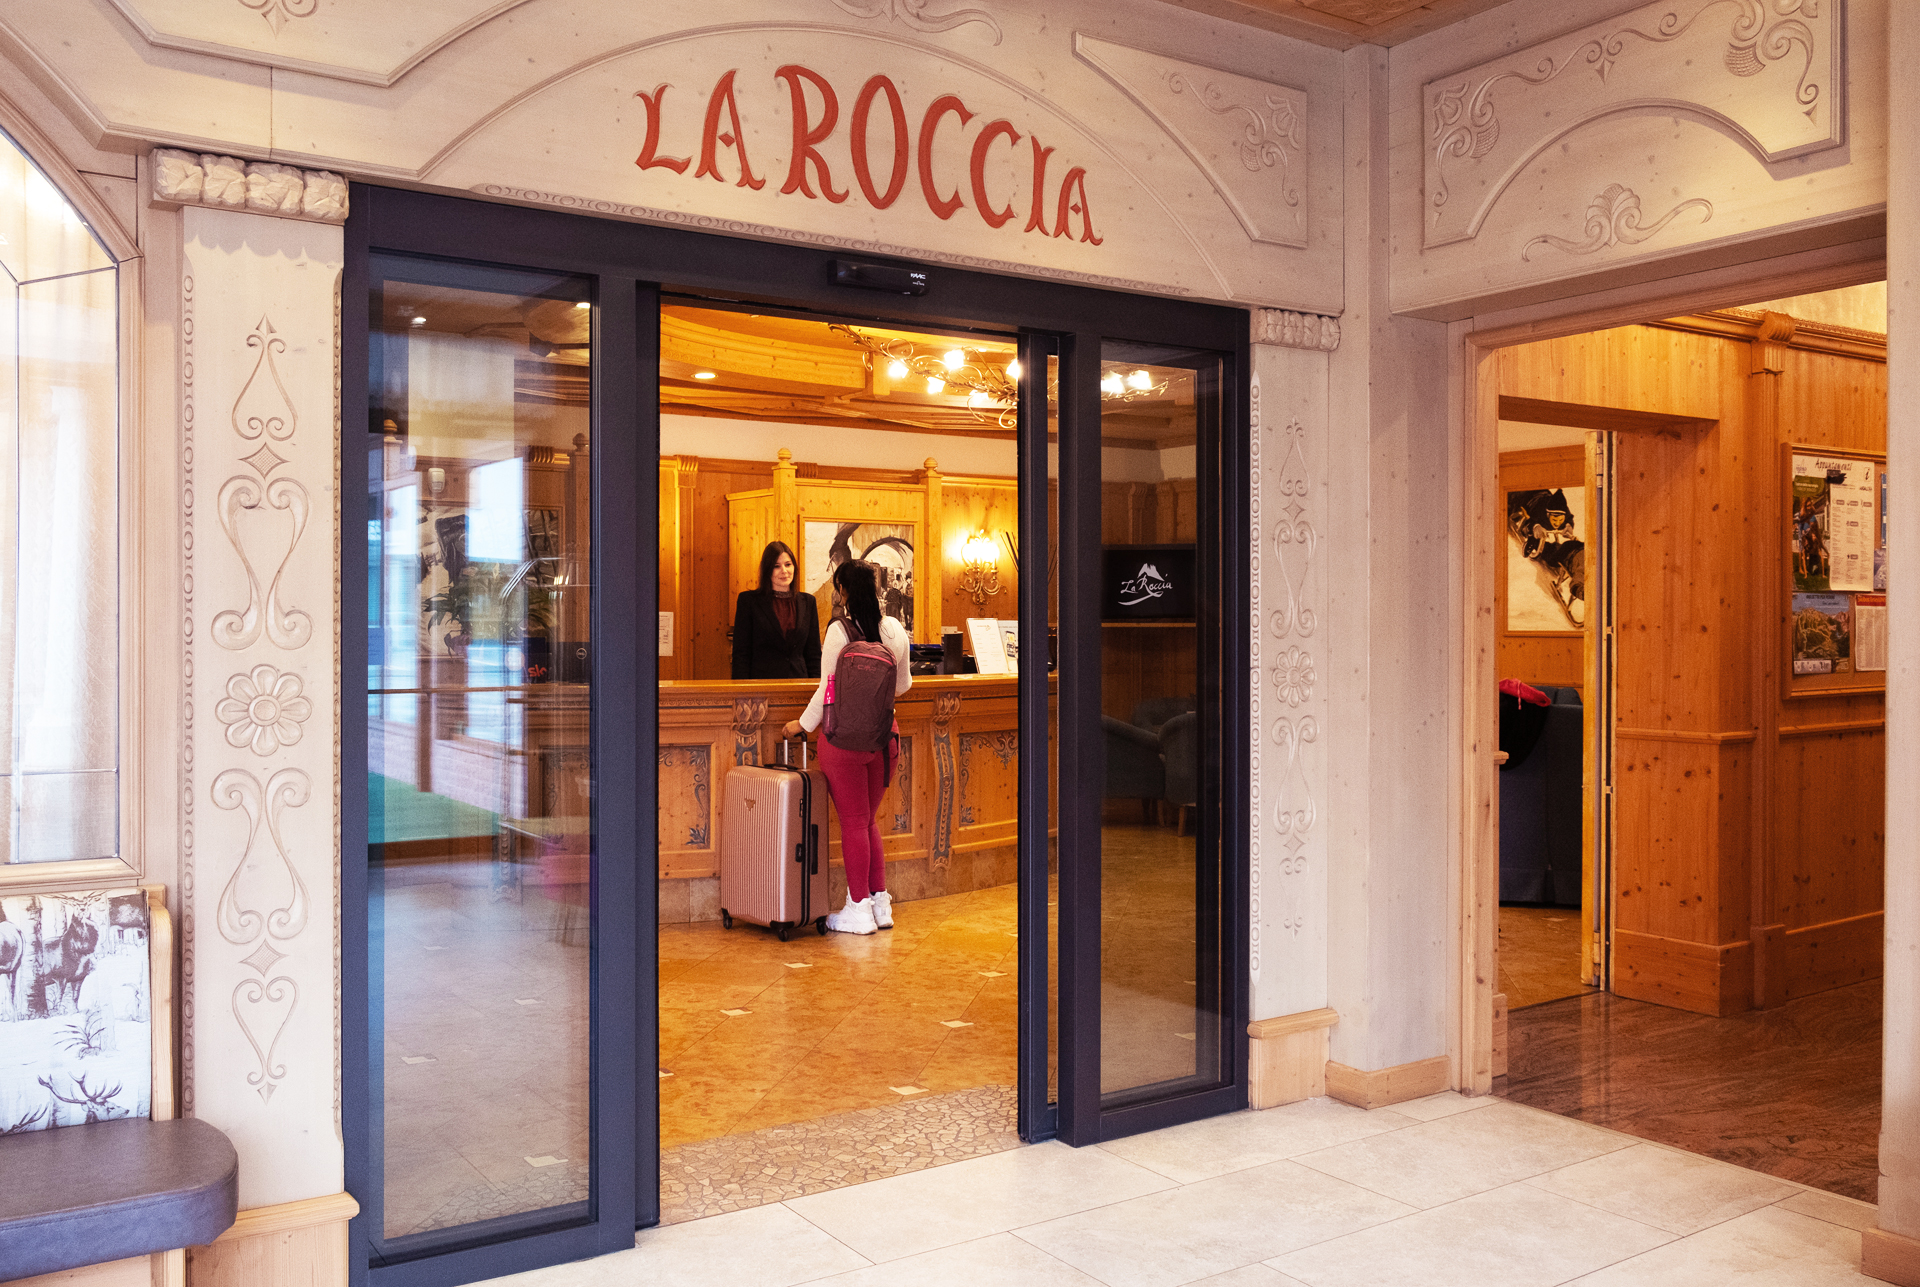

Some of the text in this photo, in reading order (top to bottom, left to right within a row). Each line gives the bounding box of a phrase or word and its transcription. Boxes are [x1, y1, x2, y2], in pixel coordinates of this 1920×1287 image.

[634, 64, 1104, 247] LA ROCCIA
[1120, 573, 1174, 598] La Roccia
